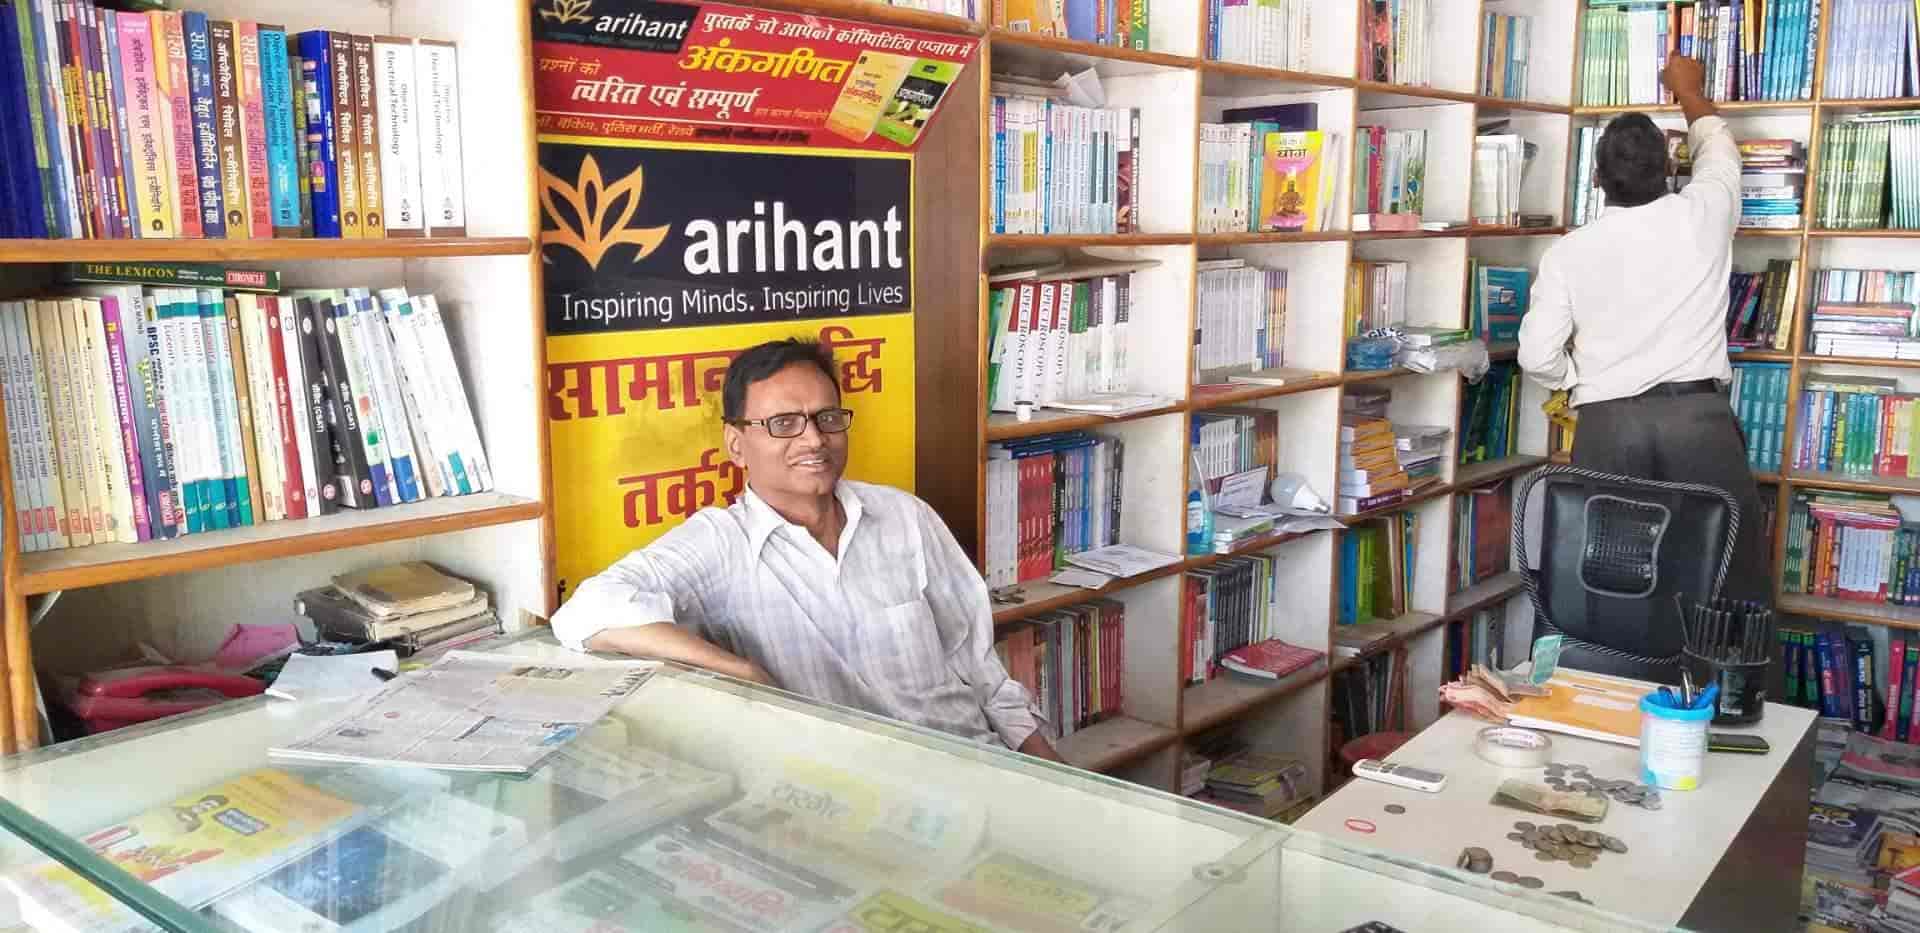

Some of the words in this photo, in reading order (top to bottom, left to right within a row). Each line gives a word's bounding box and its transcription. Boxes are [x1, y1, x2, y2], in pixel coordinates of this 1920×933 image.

[595, 13, 689, 40] arihant
[755, 16, 776, 34] जो
[386, 50, 397, 96] Electrical
[430, 52, 441, 97] Electrical
[678, 37, 853, 84] अंकगणित
[399, 83, 410, 124] Objective
[571, 75, 646, 105] त्वरित
[649, 81, 688, 107] एवं
[688, 86, 763, 119] सम्पूर्ण
[389, 99, 401, 156] Technology
[432, 100, 444, 155] Technology
[683, 201, 903, 276] arihant
[87, 264, 112, 275] THE
[116, 266, 176, 278] LEXICON
[132, 296, 141, 309] IAS
[135, 310, 144, 335] MAINS
[562, 292, 673, 327] Inspiring
[682, 288, 755, 315] Minds.
[763, 282, 851, 313] Inspiring
[857, 283, 904, 305] Lives
[147, 326, 160, 356] BPSC
[1016, 287, 1032, 379] SPECTROSCOPY
[1035, 286, 1052, 377] SPECTROSCOPY
[1056, 286, 1070, 376] SPECTROSCOPY
[312, 406, 325, 432] (CSAT)
[344, 404, 357, 430] (CSAT)
